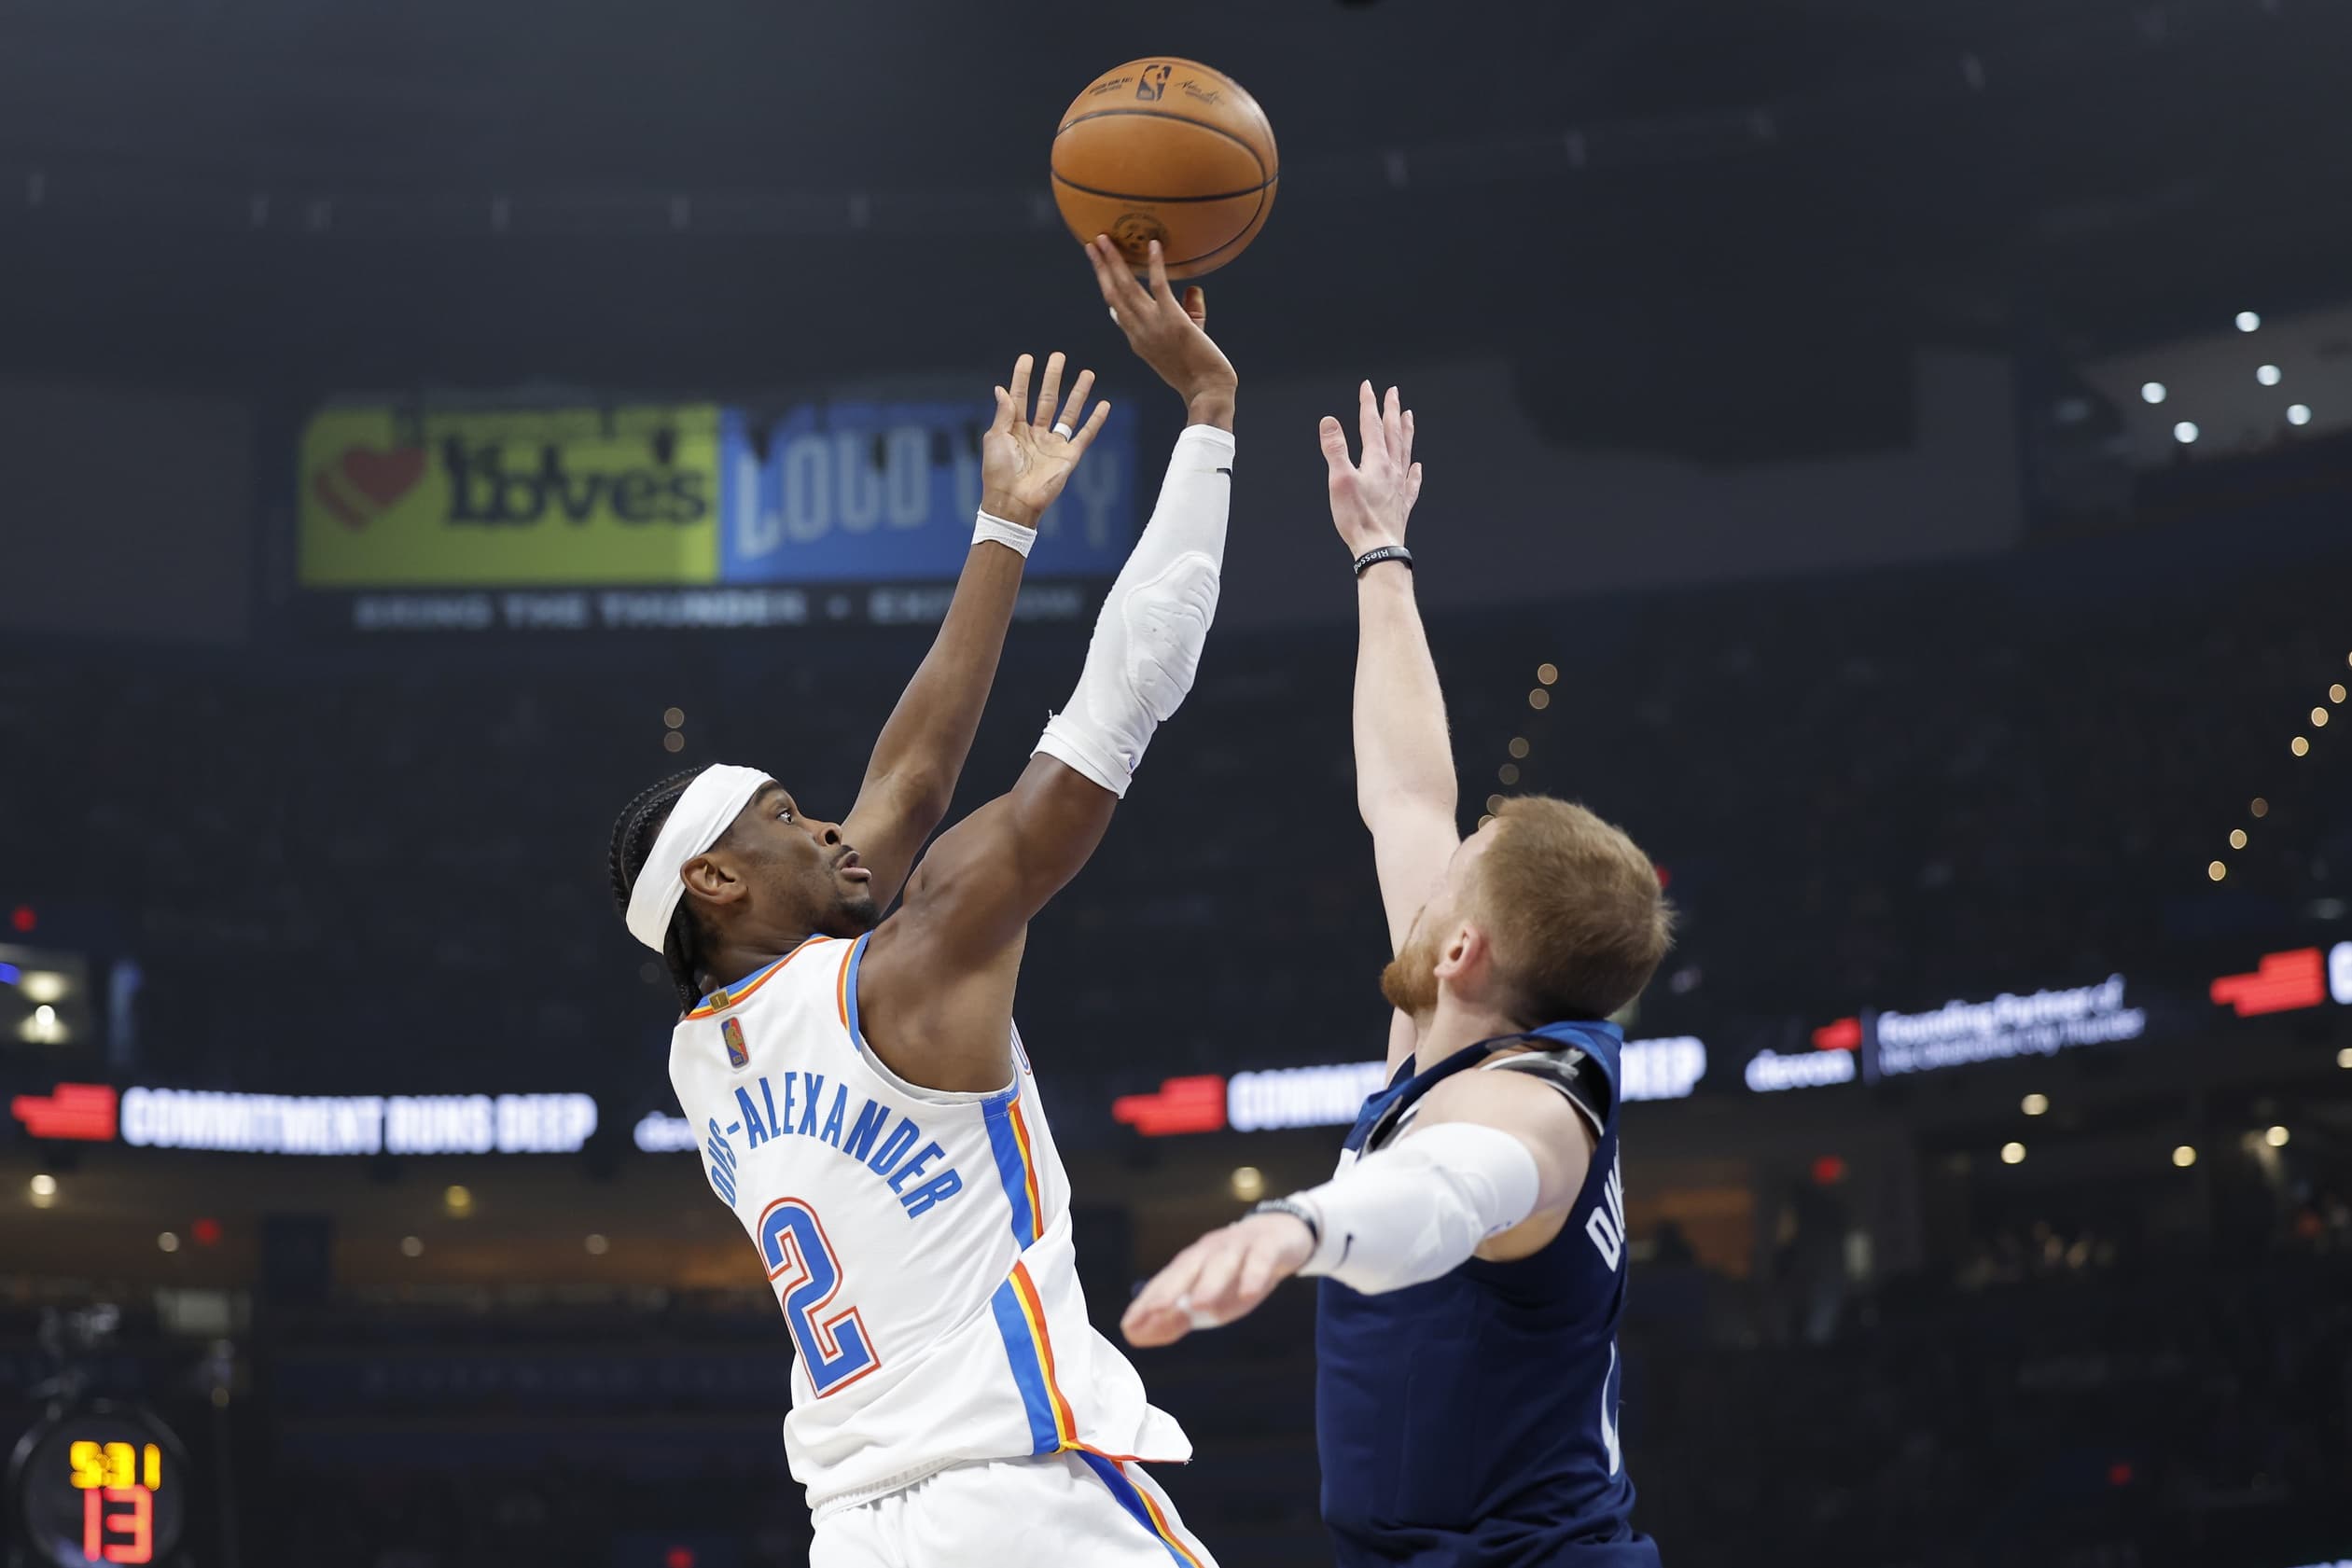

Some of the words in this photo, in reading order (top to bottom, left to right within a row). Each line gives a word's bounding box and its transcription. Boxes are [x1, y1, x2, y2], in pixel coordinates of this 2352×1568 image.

[502, 592, 588, 628] THE
[600, 590, 808, 627] THUNDER
[1745, 1048, 1856, 1092] devon
[121, 1086, 384, 1155] COMMITMENT
[384, 1094, 494, 1154] RUNS
[495, 1093, 597, 1153] DEEP
[708, 1072, 963, 1220] OUS-ALEXANDER
[758, 1197, 881, 1399] 2
[84, 1485, 152, 1563] 13
